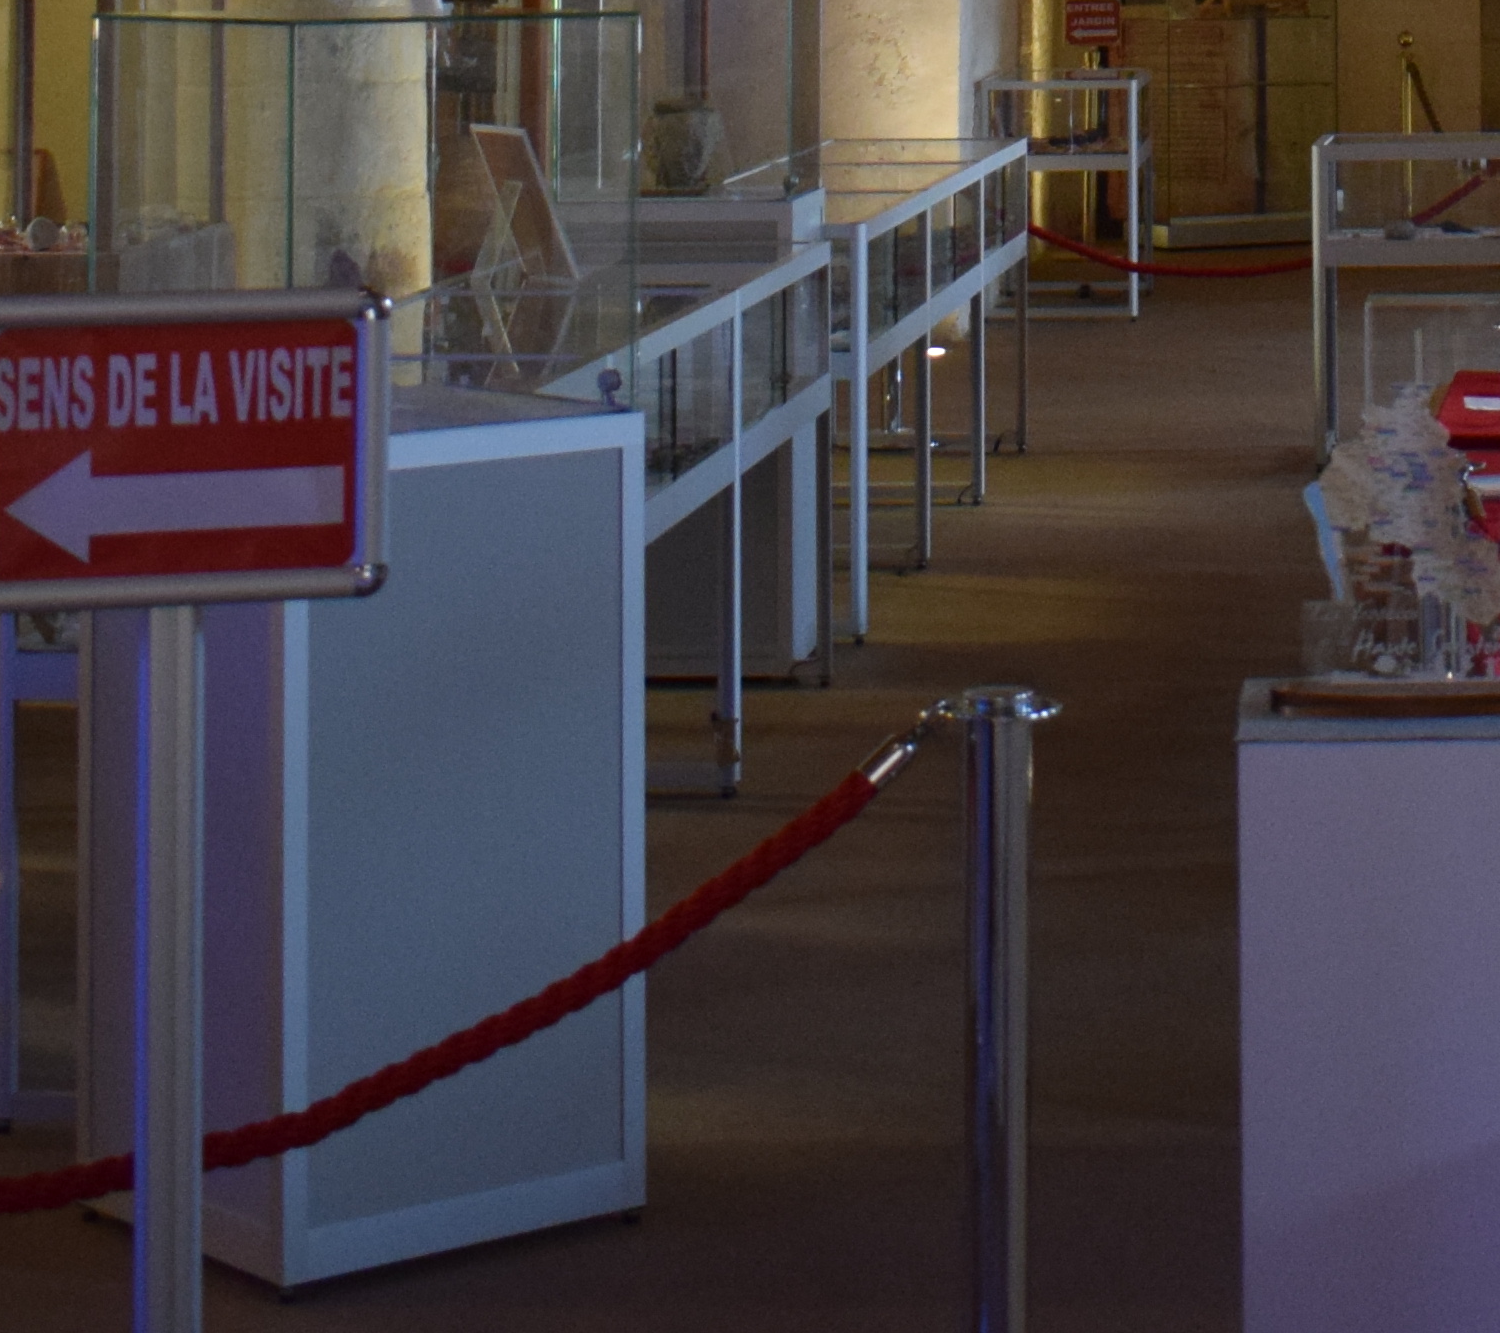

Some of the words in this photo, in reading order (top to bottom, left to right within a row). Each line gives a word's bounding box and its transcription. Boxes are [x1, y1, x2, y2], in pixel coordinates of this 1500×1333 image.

[107, 353, 158, 427] DE
[169, 350, 219, 426] LA
[228, 345, 355, 423] VISITE
